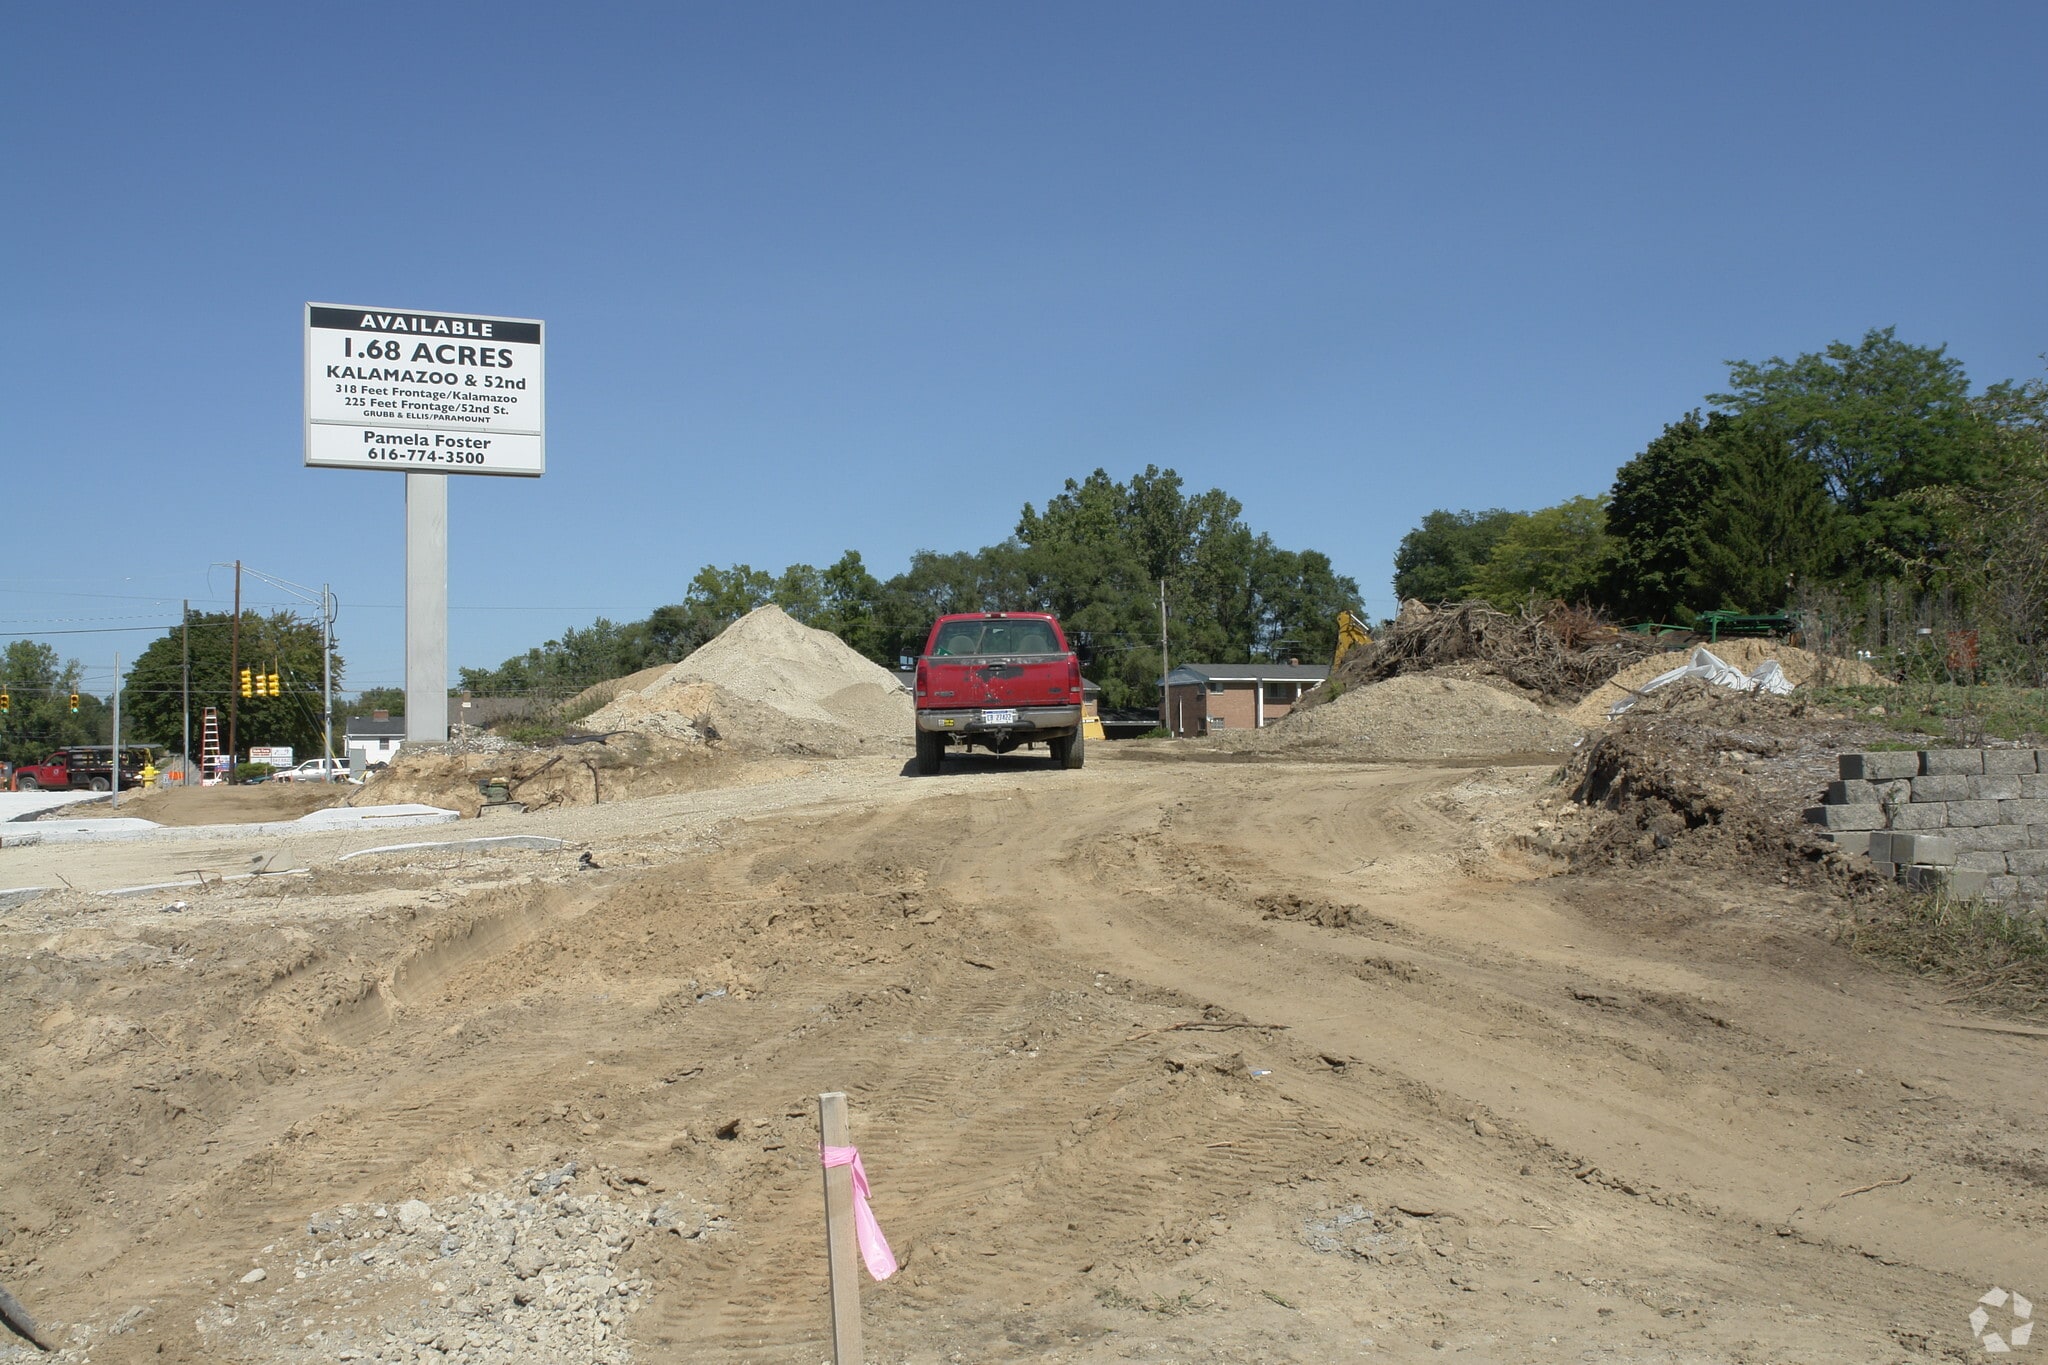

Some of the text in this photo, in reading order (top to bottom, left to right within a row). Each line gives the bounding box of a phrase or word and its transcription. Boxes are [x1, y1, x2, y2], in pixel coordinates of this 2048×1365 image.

[360, 314, 492, 337] AVAILABLE
[344, 337, 513, 368] 1.68 ACRES
[327, 365, 526, 390] KALAMAZOO & 52nd
[336, 384, 517, 403] 318 Feet Frontage/Kalamazoo
[345, 397, 509, 414] 225 Feet Frontage/52nd St.
[364, 410, 394, 418] GRUBB
[406, 412, 490, 423] ELLIS/PARAMOUNT
[364, 431, 491, 449] Pamela Foster
[368, 448, 484, 464] 616-774-3500
